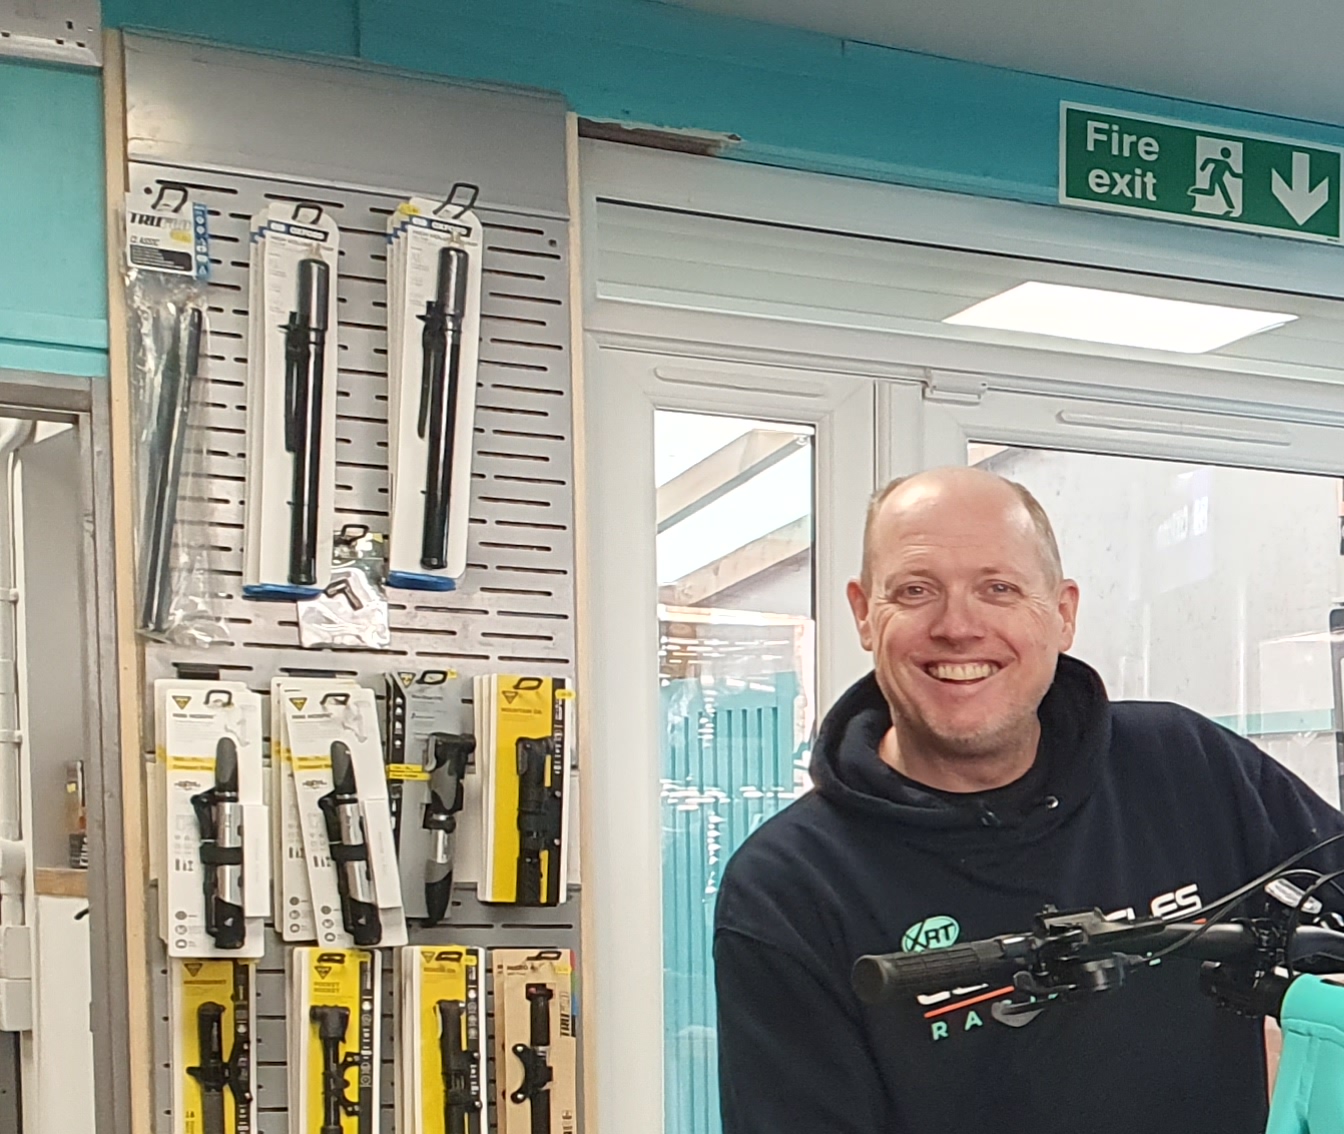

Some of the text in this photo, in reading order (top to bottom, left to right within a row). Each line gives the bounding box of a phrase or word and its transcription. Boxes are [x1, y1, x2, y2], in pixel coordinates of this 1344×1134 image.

[1086, 120, 1159, 161] Fire
[1088, 168, 1157, 200] exit
[904, 921, 954, 951] XRT
